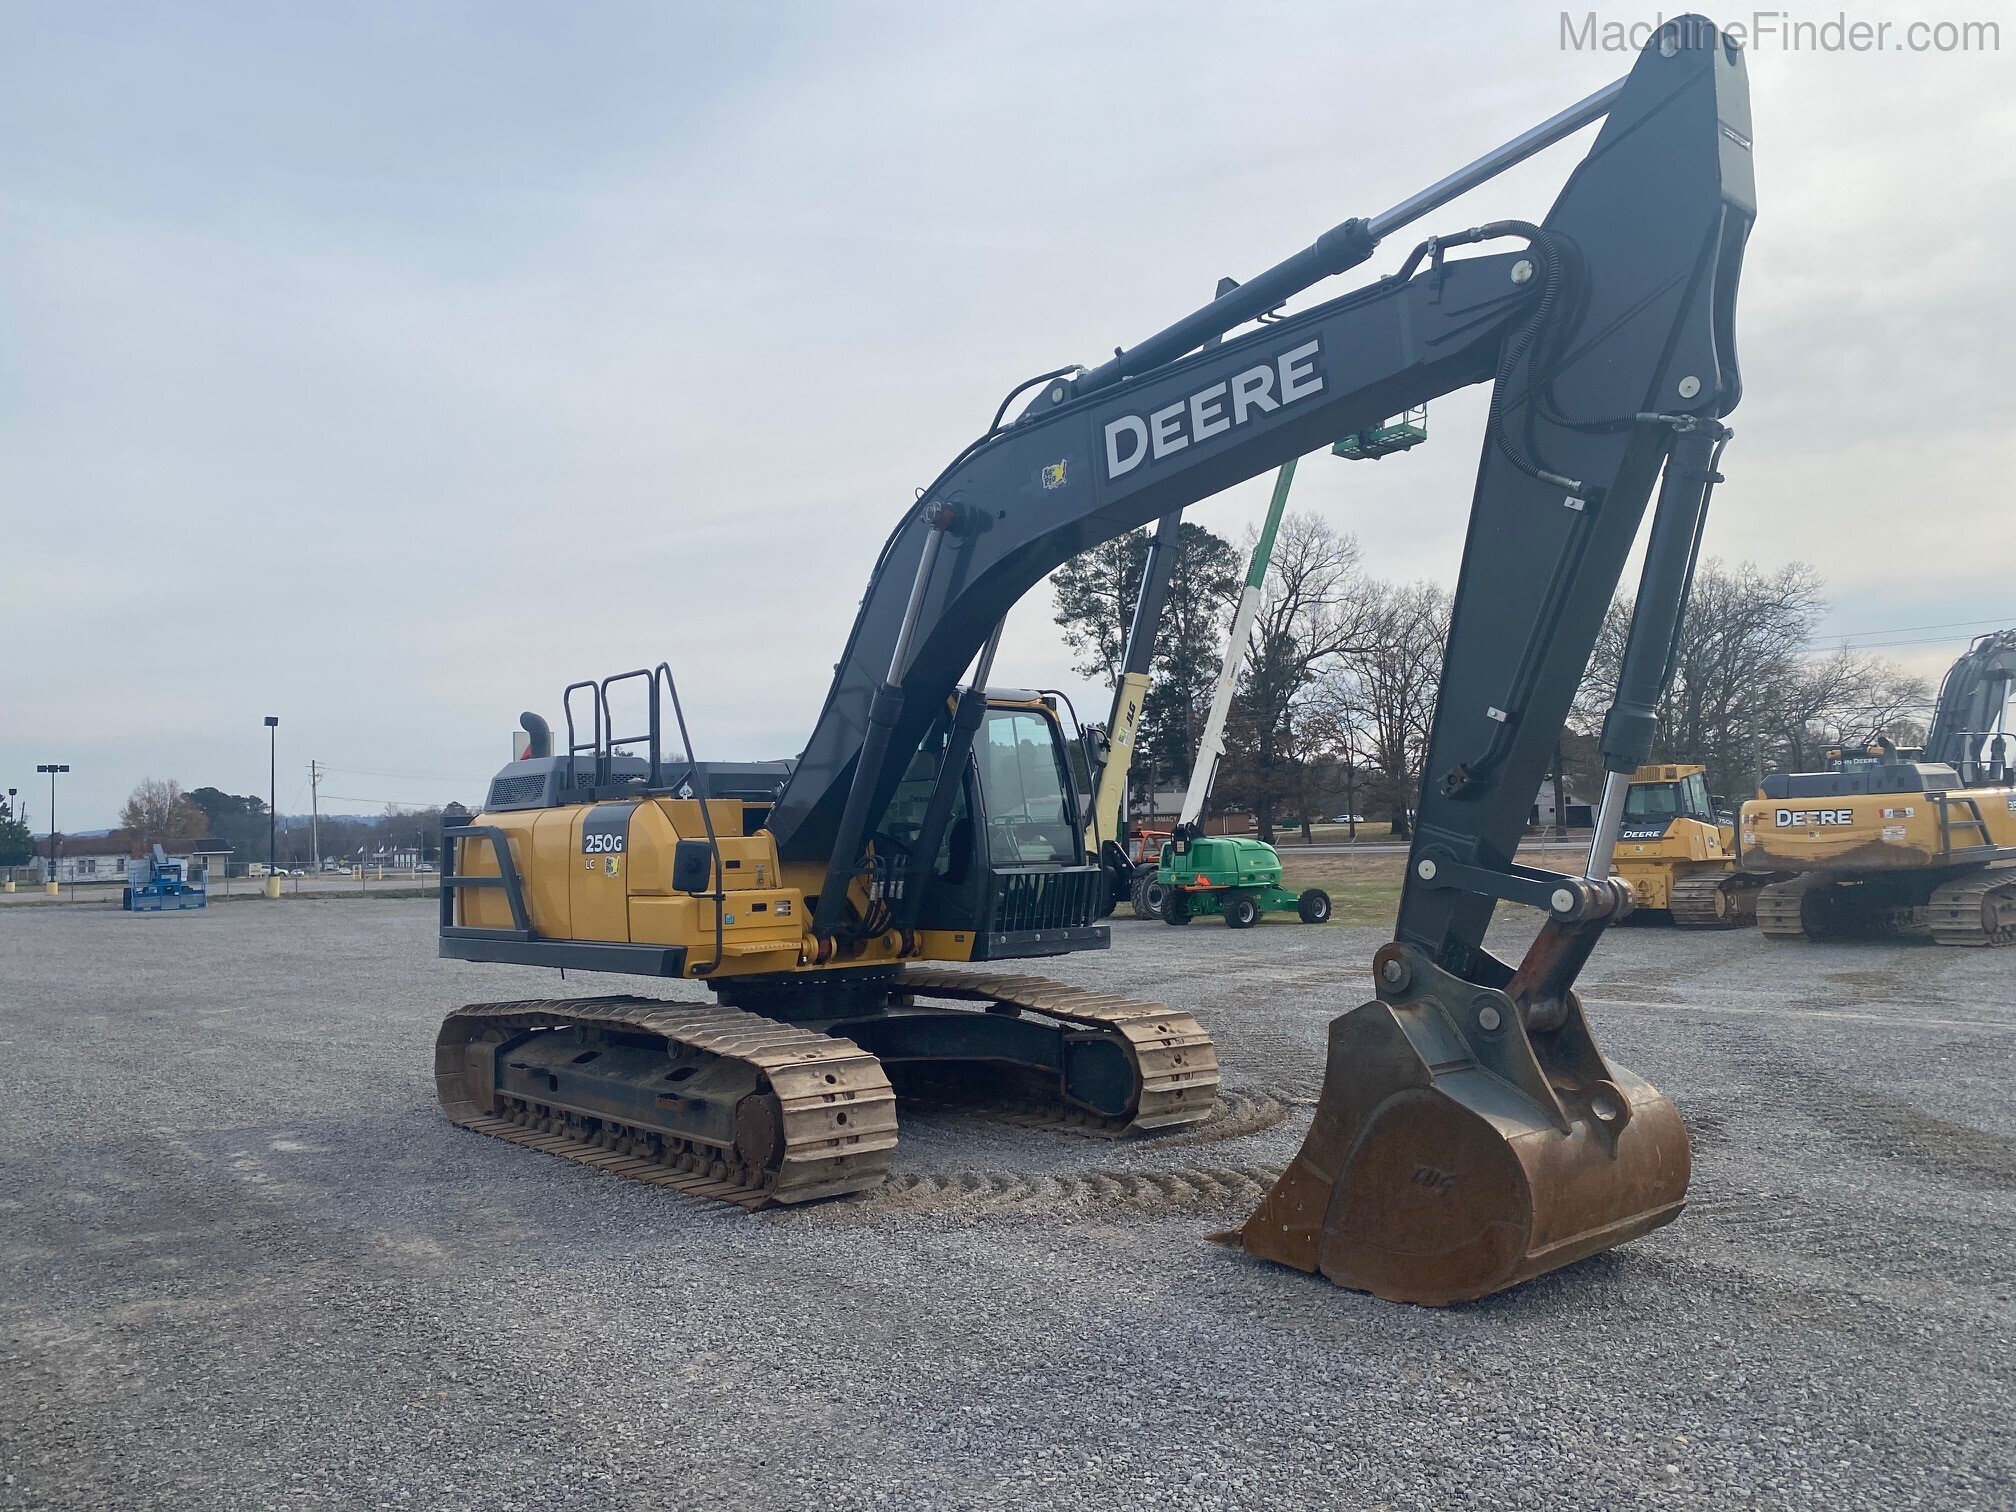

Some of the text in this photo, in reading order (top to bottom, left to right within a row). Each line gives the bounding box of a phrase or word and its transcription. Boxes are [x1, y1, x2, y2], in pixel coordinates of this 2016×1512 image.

[1105, 339, 1323, 479] DEERE
[1126, 700, 1136, 728] JLG
[585, 833, 623, 852] 250G
[585, 859, 595, 870] LC
